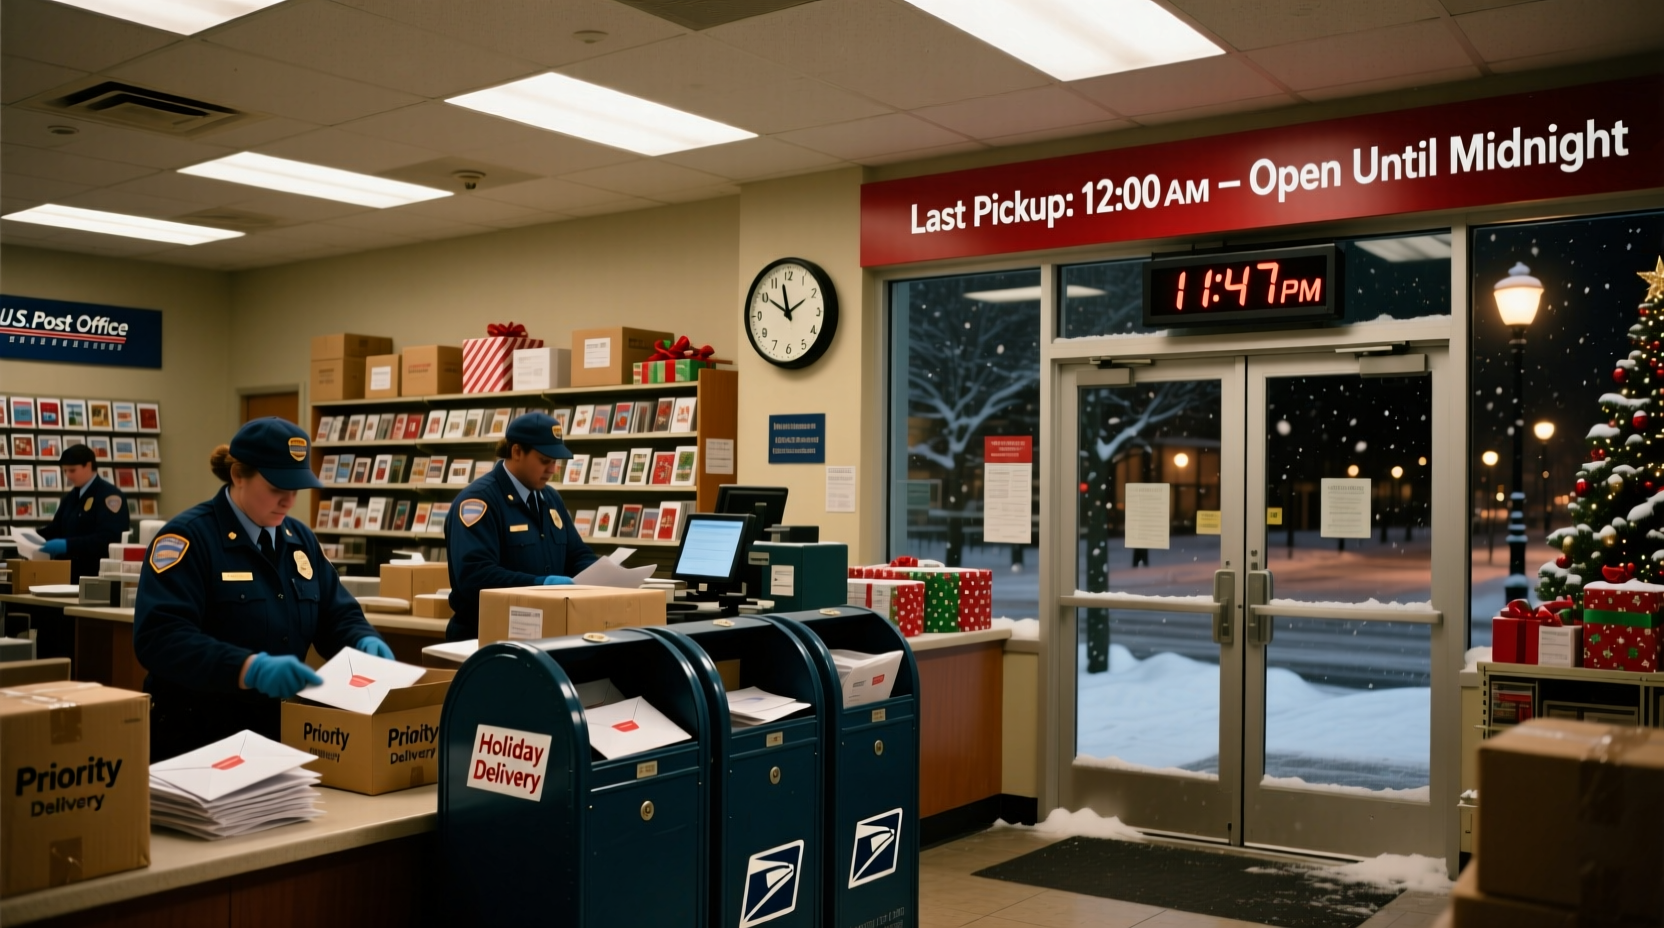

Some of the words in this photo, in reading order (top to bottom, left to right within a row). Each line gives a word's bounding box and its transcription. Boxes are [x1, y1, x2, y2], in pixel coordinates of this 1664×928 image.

[911, 200, 966, 235] Last
[973, 189, 1074, 229] Pickup:
[1081, 173, 1161, 215] 12:00
[1164, 178, 1210, 207] AM
[1249, 158, 1341, 203] Open
[1353, 137, 1437, 184] Until
[1450, 118, 1629, 173] Midnight
[784, 270, 794, 281] 12
[1176, 261, 1279, 310] 11:47
[1280, 277, 1322, 304] PM
[810, 287, 817, 299] 2
[32, 310, 73, 332] Post
[76, 314, 129, 336] Office
[771, 339, 778, 351] 7
[785, 343, 792, 355] 6
[800, 338, 807, 350] 5
[478, 732, 544, 768] Holiday
[15, 756, 123, 797] Priority
[473, 759, 541, 795] Delivery
[30, 794, 105, 818] Delivery
